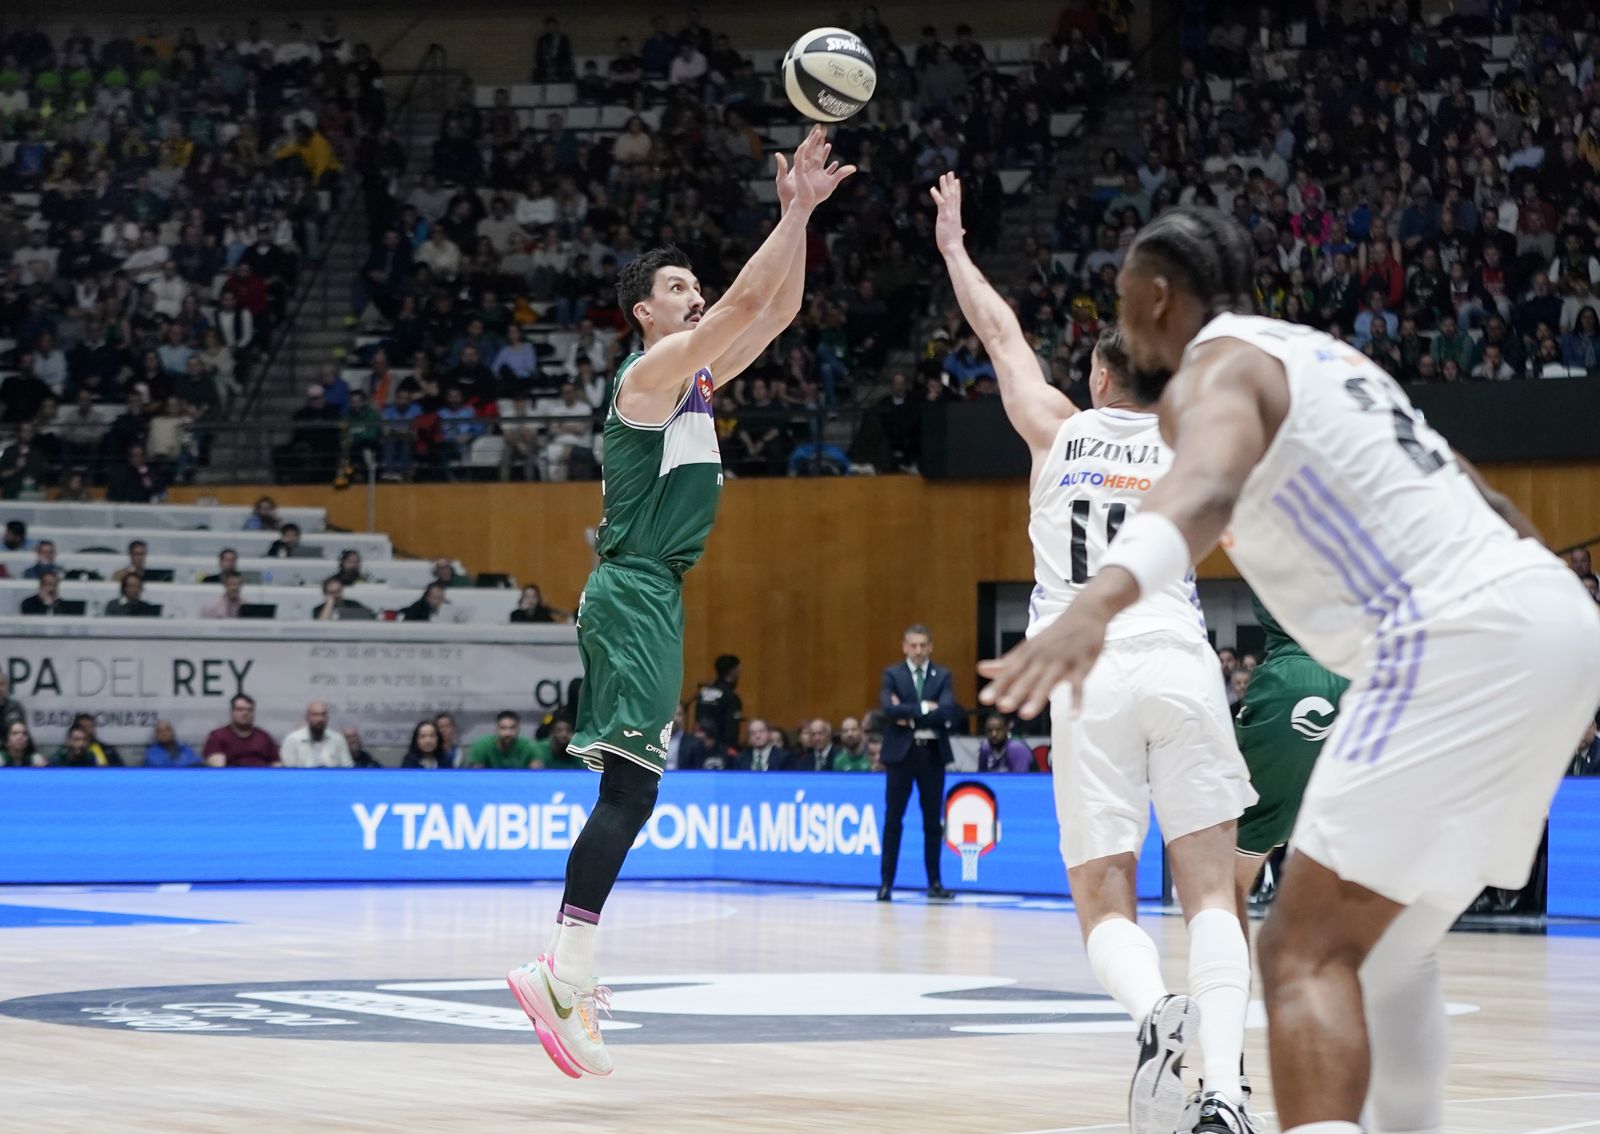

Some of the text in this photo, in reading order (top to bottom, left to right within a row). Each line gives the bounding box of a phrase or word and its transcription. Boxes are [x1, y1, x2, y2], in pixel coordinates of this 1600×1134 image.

[1064, 437, 1160, 465] HEZONJA
[1059, 471, 1152, 492] AUTOHERO
[76, 657, 157, 697] DEL
[172, 658, 254, 697] REY
[352, 803, 389, 850] Y
[630, 803, 719, 850] ON
[721, 804, 757, 851] LA
[759, 789, 882, 856] MÚSICA
